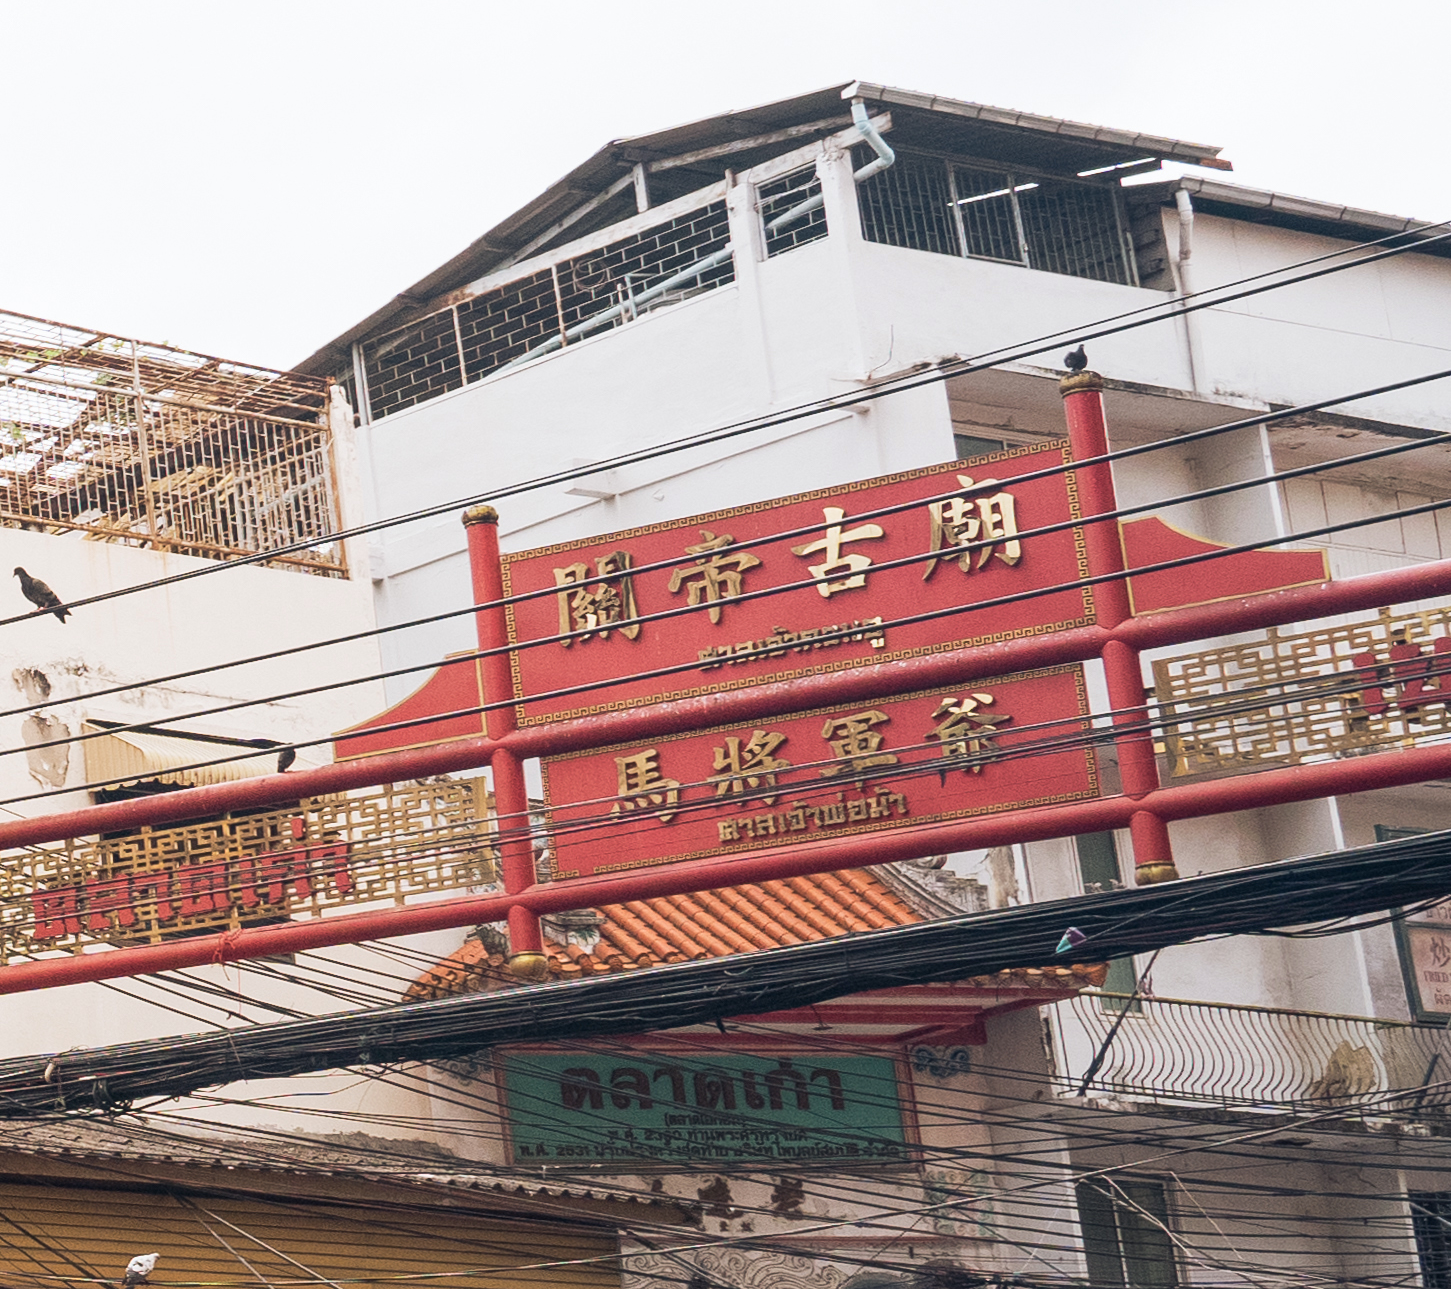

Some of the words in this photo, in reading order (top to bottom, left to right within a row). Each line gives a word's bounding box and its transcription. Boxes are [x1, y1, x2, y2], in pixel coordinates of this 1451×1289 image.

[553, 474, 1021, 648] 關帝古廟
[610, 692, 1013, 824] 馬將軍爺
[560, 1057, 847, 1112] ตลาดเก่า
